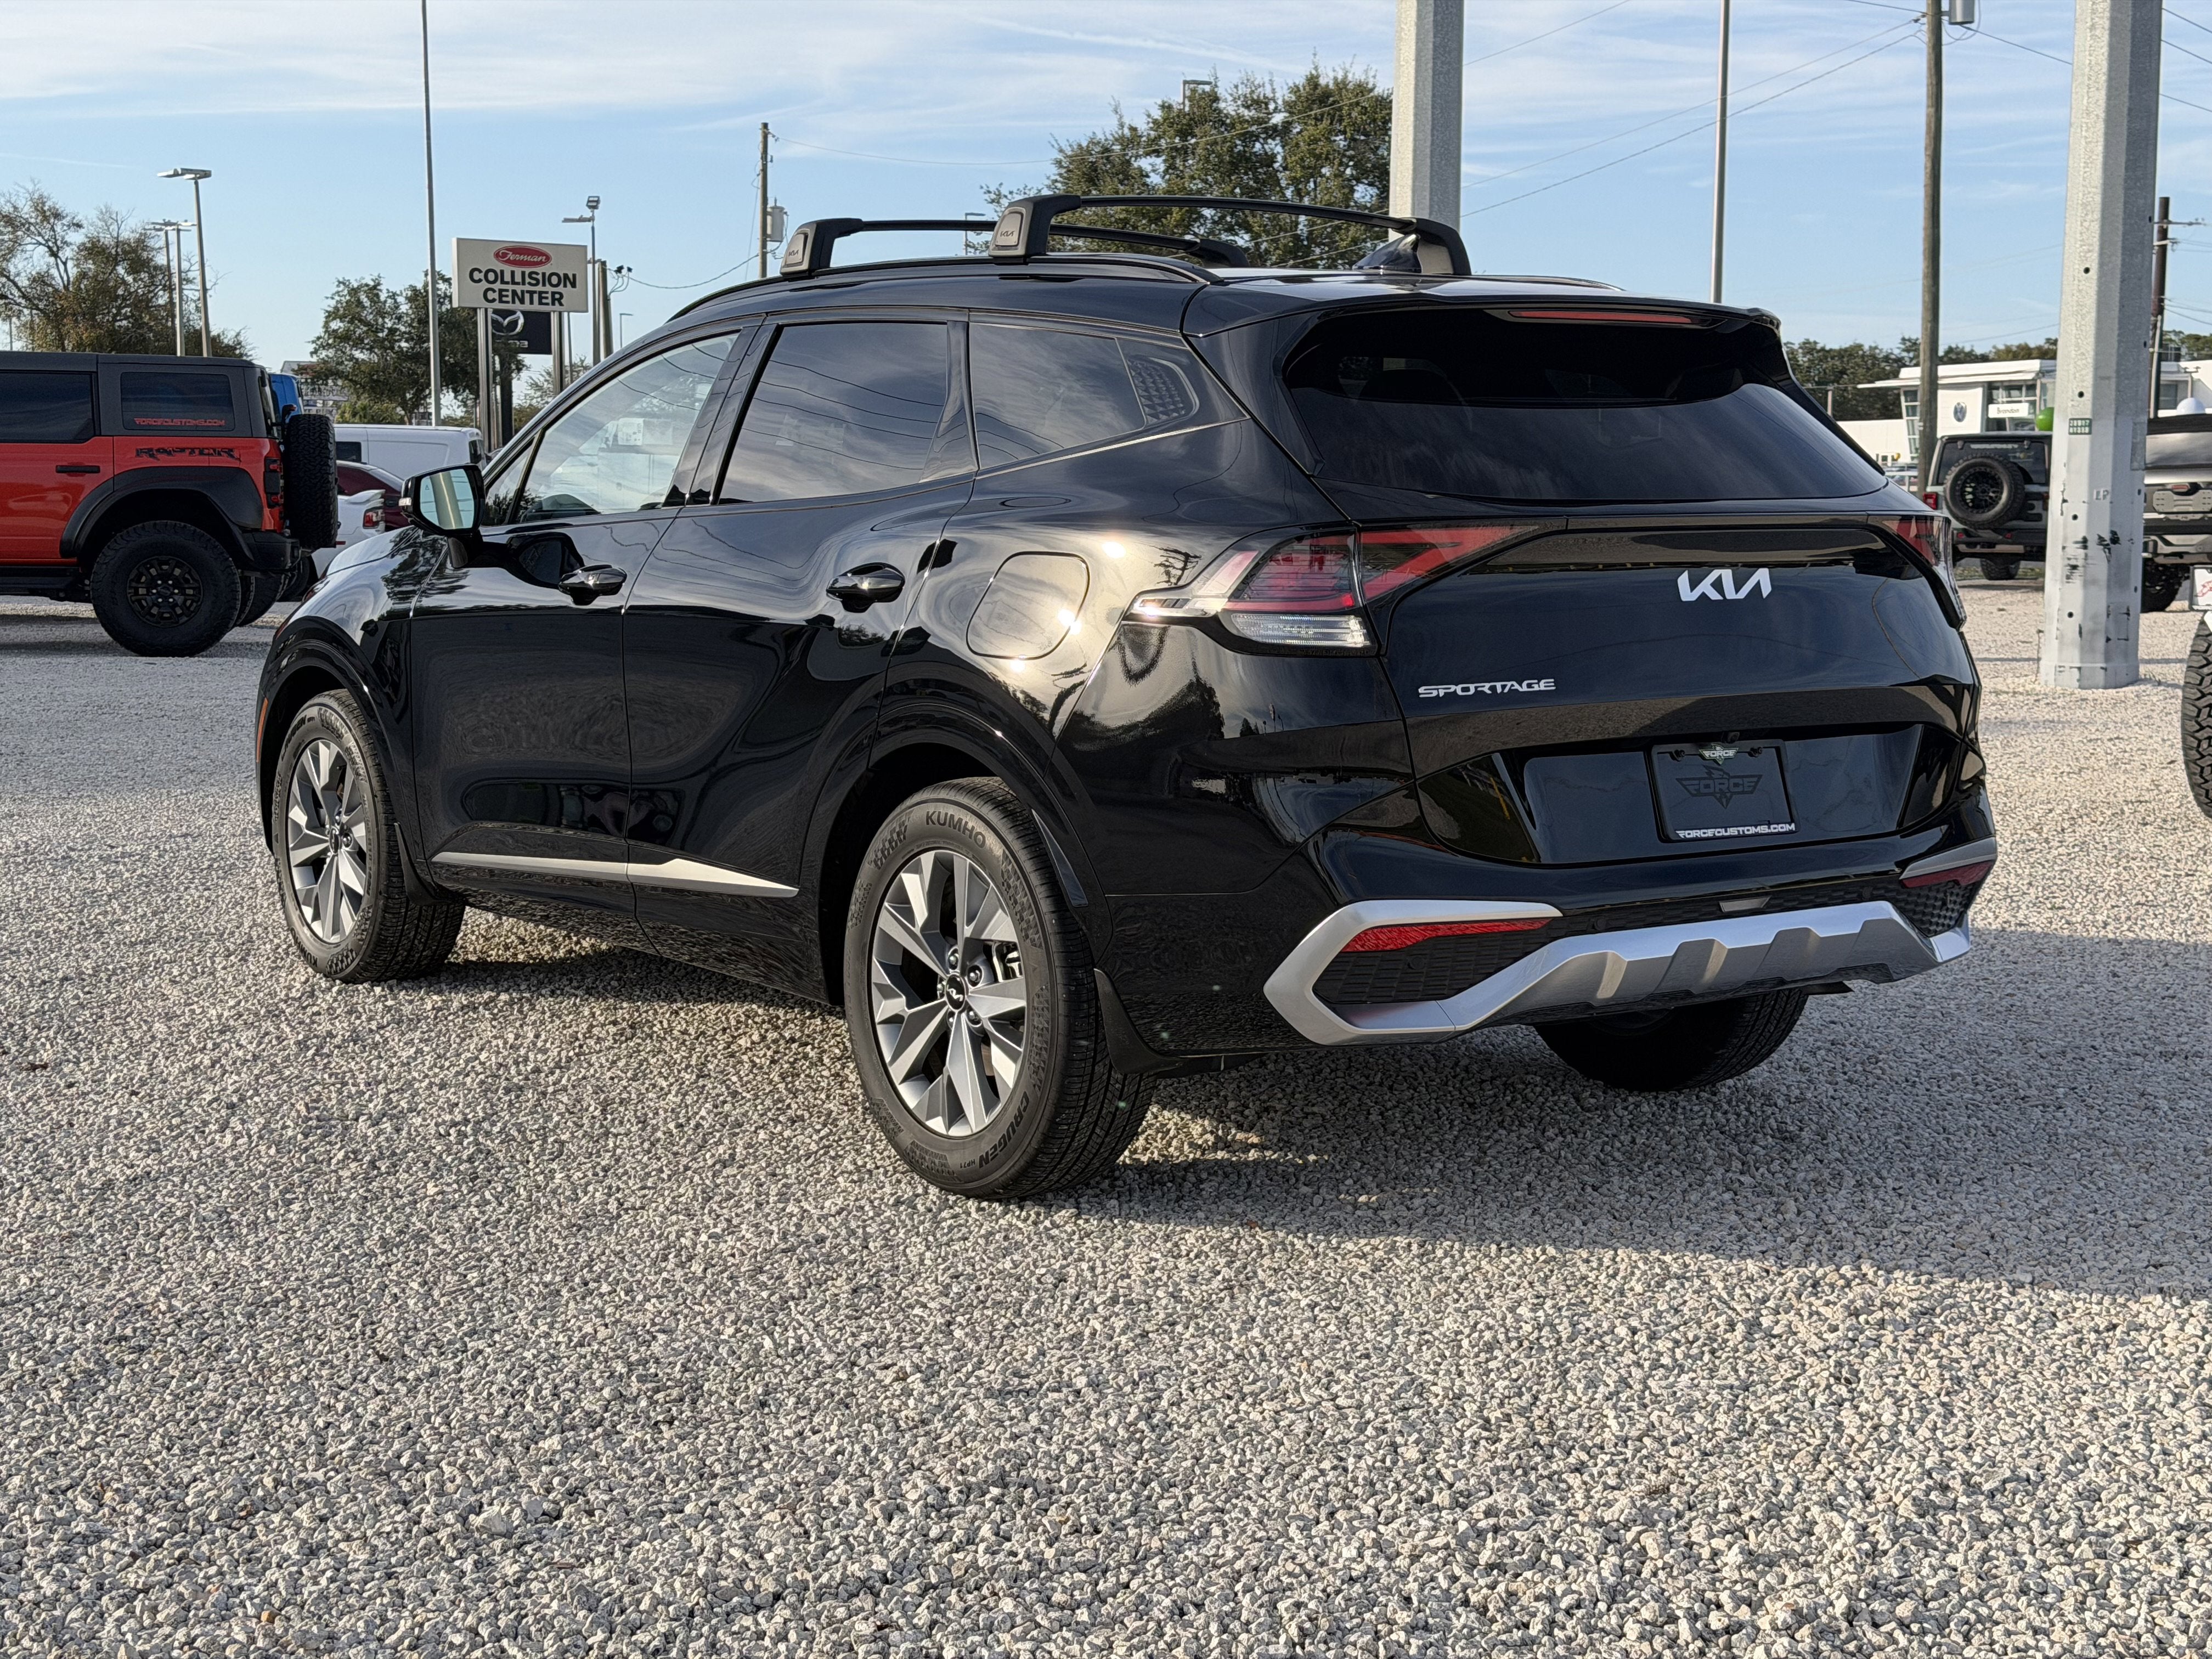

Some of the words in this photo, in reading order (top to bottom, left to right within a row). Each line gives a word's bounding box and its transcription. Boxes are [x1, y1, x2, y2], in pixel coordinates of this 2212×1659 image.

[499, 250, 548, 262] Ferman
[469, 267, 577, 289] COLLISION
[483, 287, 565, 307] CENTER
[135, 447, 242, 462] RAPTOR
[1677, 567, 1773, 602] KIA
[1418, 679, 1557, 698] SPORTAGE
[1703, 750, 1737, 758] FORCE
[1681, 777, 1758, 794] FORCE
[926, 810, 986, 849] KUMHO
[1675, 823, 1796, 839] FORCECUSTOMS.COM
[978, 1090, 1030, 1169] CRUGEN
[960, 1158, 975, 1169] HP71
